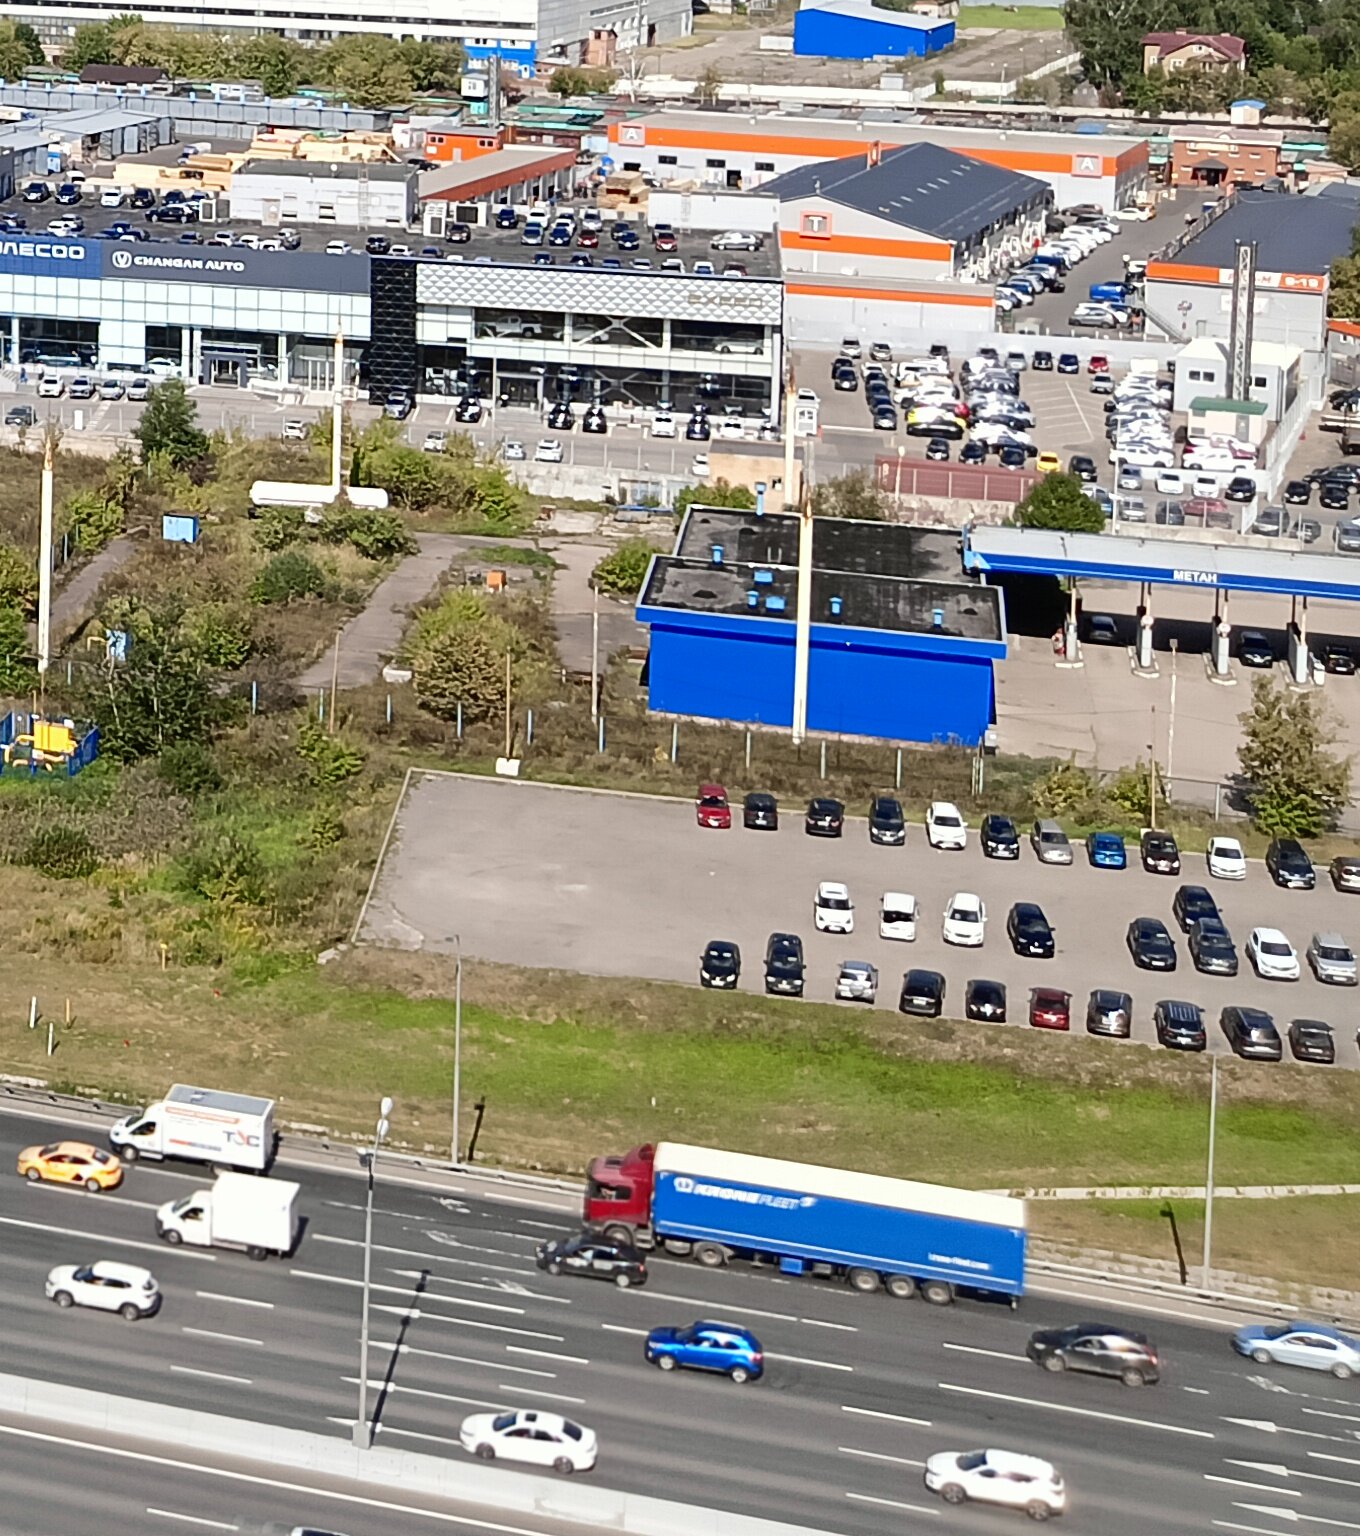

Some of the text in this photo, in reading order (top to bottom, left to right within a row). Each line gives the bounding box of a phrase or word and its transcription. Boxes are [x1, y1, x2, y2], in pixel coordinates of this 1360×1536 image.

[133, 255, 245, 272] CHANGAN AUTO
[1173, 570, 1217, 583] МЕТАН
[759, 1194, 800, 1210] FLEET
